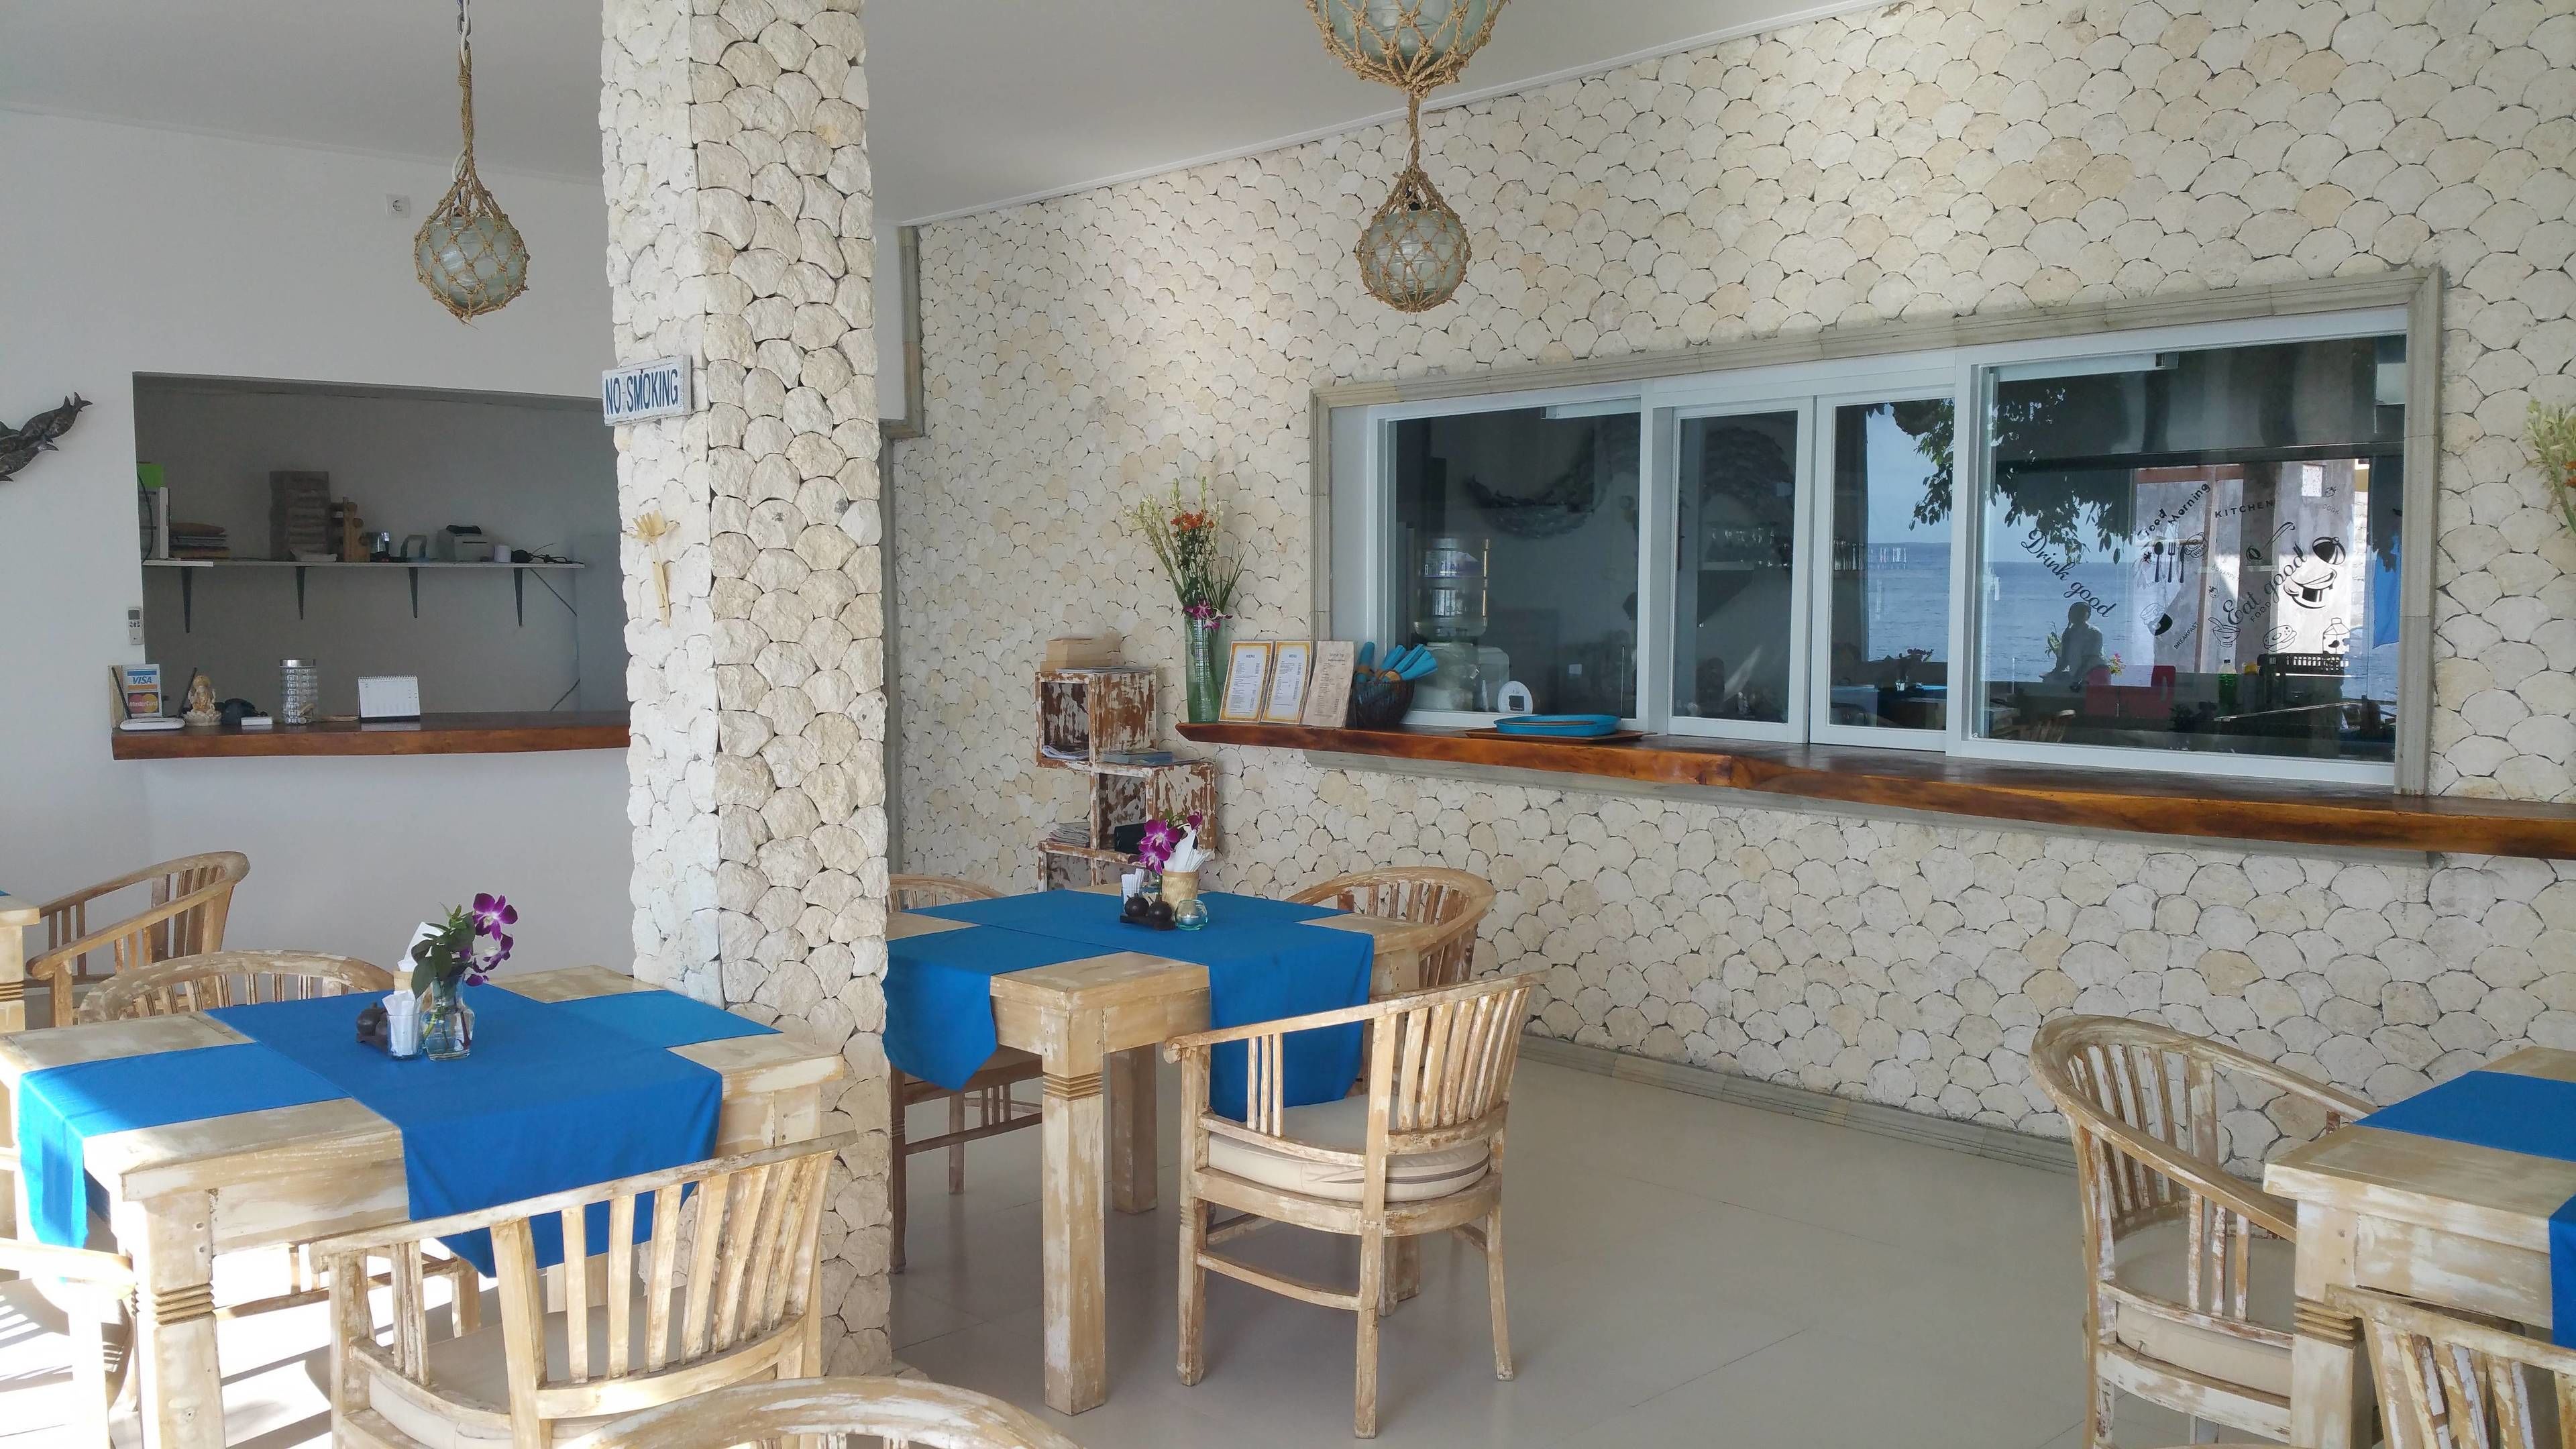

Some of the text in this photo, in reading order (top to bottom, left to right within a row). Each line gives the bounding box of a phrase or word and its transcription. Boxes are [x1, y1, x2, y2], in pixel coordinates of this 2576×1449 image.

[605, 369, 678, 415] NO SMOKING
[2168, 482, 2211, 525] Morning
[2214, 499, 2275, 519] KITCHEN
[2021, 527, 2117, 618] Drink good
[2222, 541, 2308, 625] Eat good
[2250, 601, 2271, 623] FOOD
[2174, 622, 2199, 649] BREAKFAST
[132, 676, 152, 684] VISA
